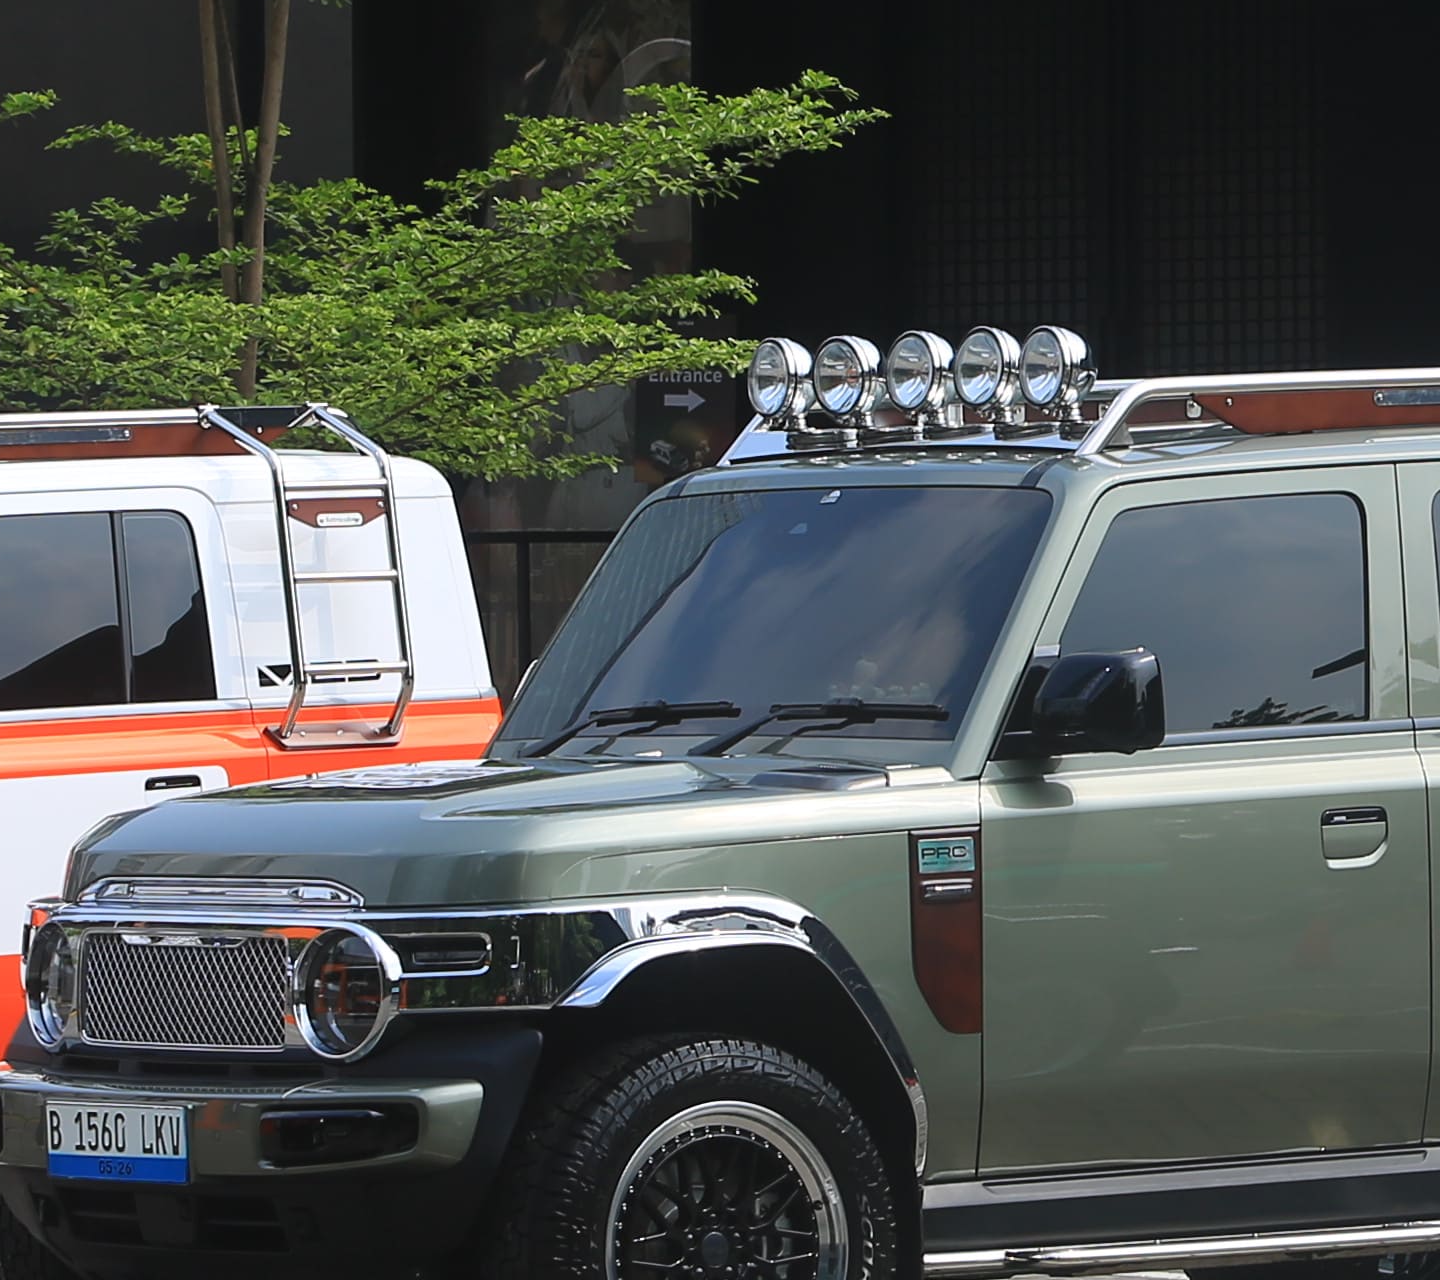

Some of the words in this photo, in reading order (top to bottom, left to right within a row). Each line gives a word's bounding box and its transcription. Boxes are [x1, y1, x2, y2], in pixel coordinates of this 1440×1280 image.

[49, 1110, 62, 1150] B
[74, 1111, 126, 1153] 1560
[141, 1114, 180, 1156] LKV
[99, 1160, 133, 1175] 05-26
